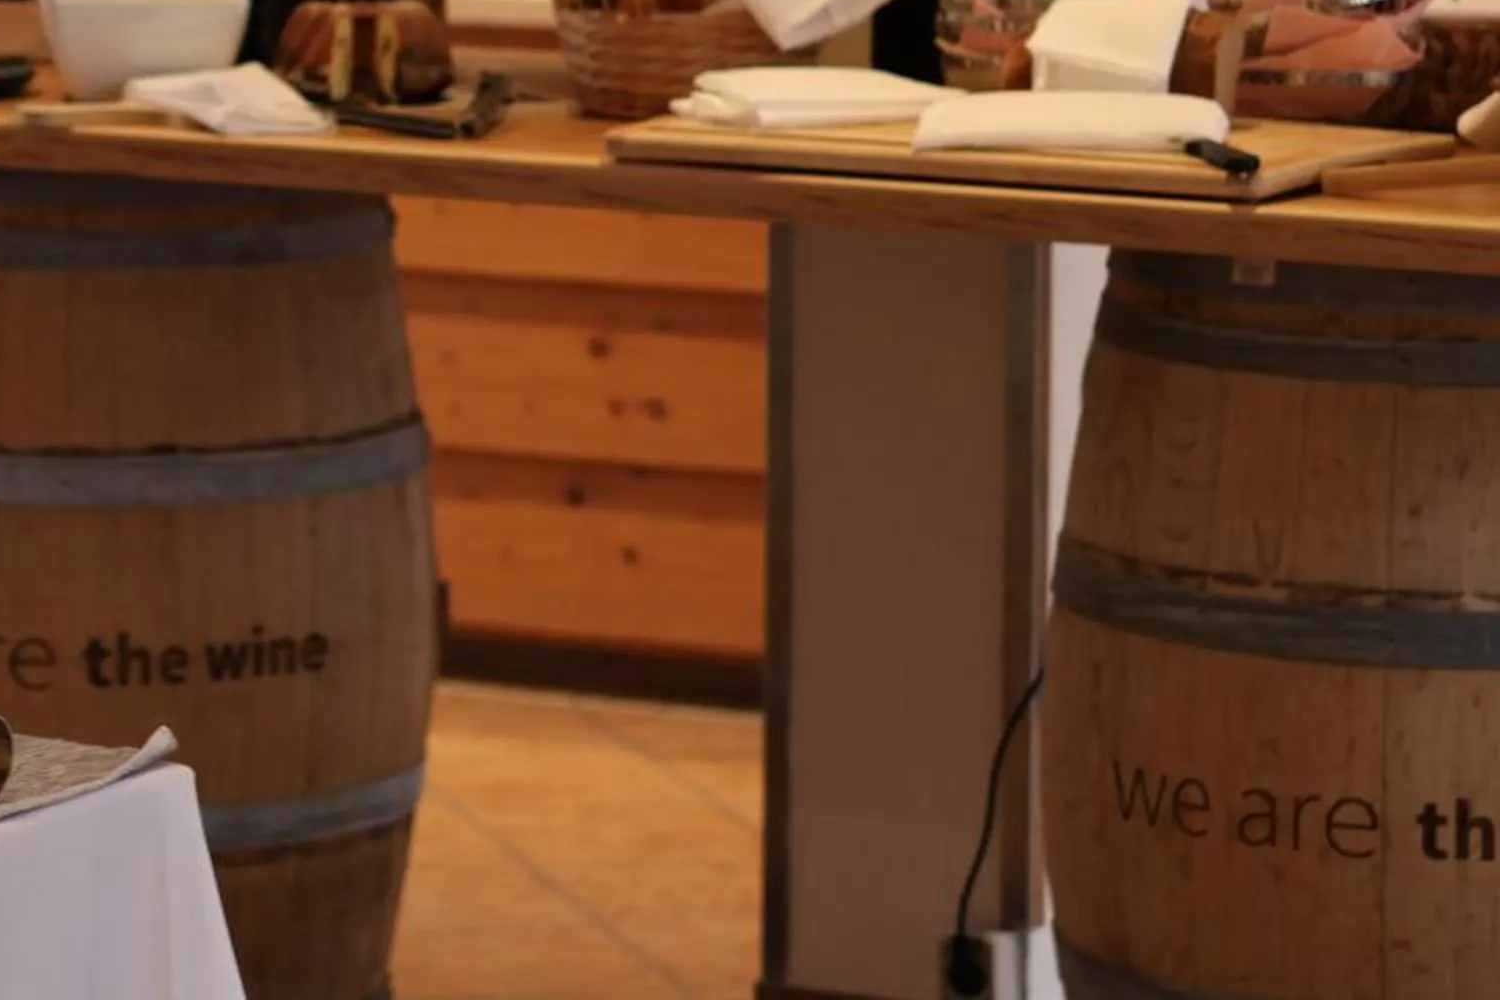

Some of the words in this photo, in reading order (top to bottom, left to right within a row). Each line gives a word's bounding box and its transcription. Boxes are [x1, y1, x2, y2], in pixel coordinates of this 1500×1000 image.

[82, 629, 189, 688] the
[204, 624, 329, 680] wine
[1236, 786, 1379, 859] are
[1415, 797, 1496, 862] th
